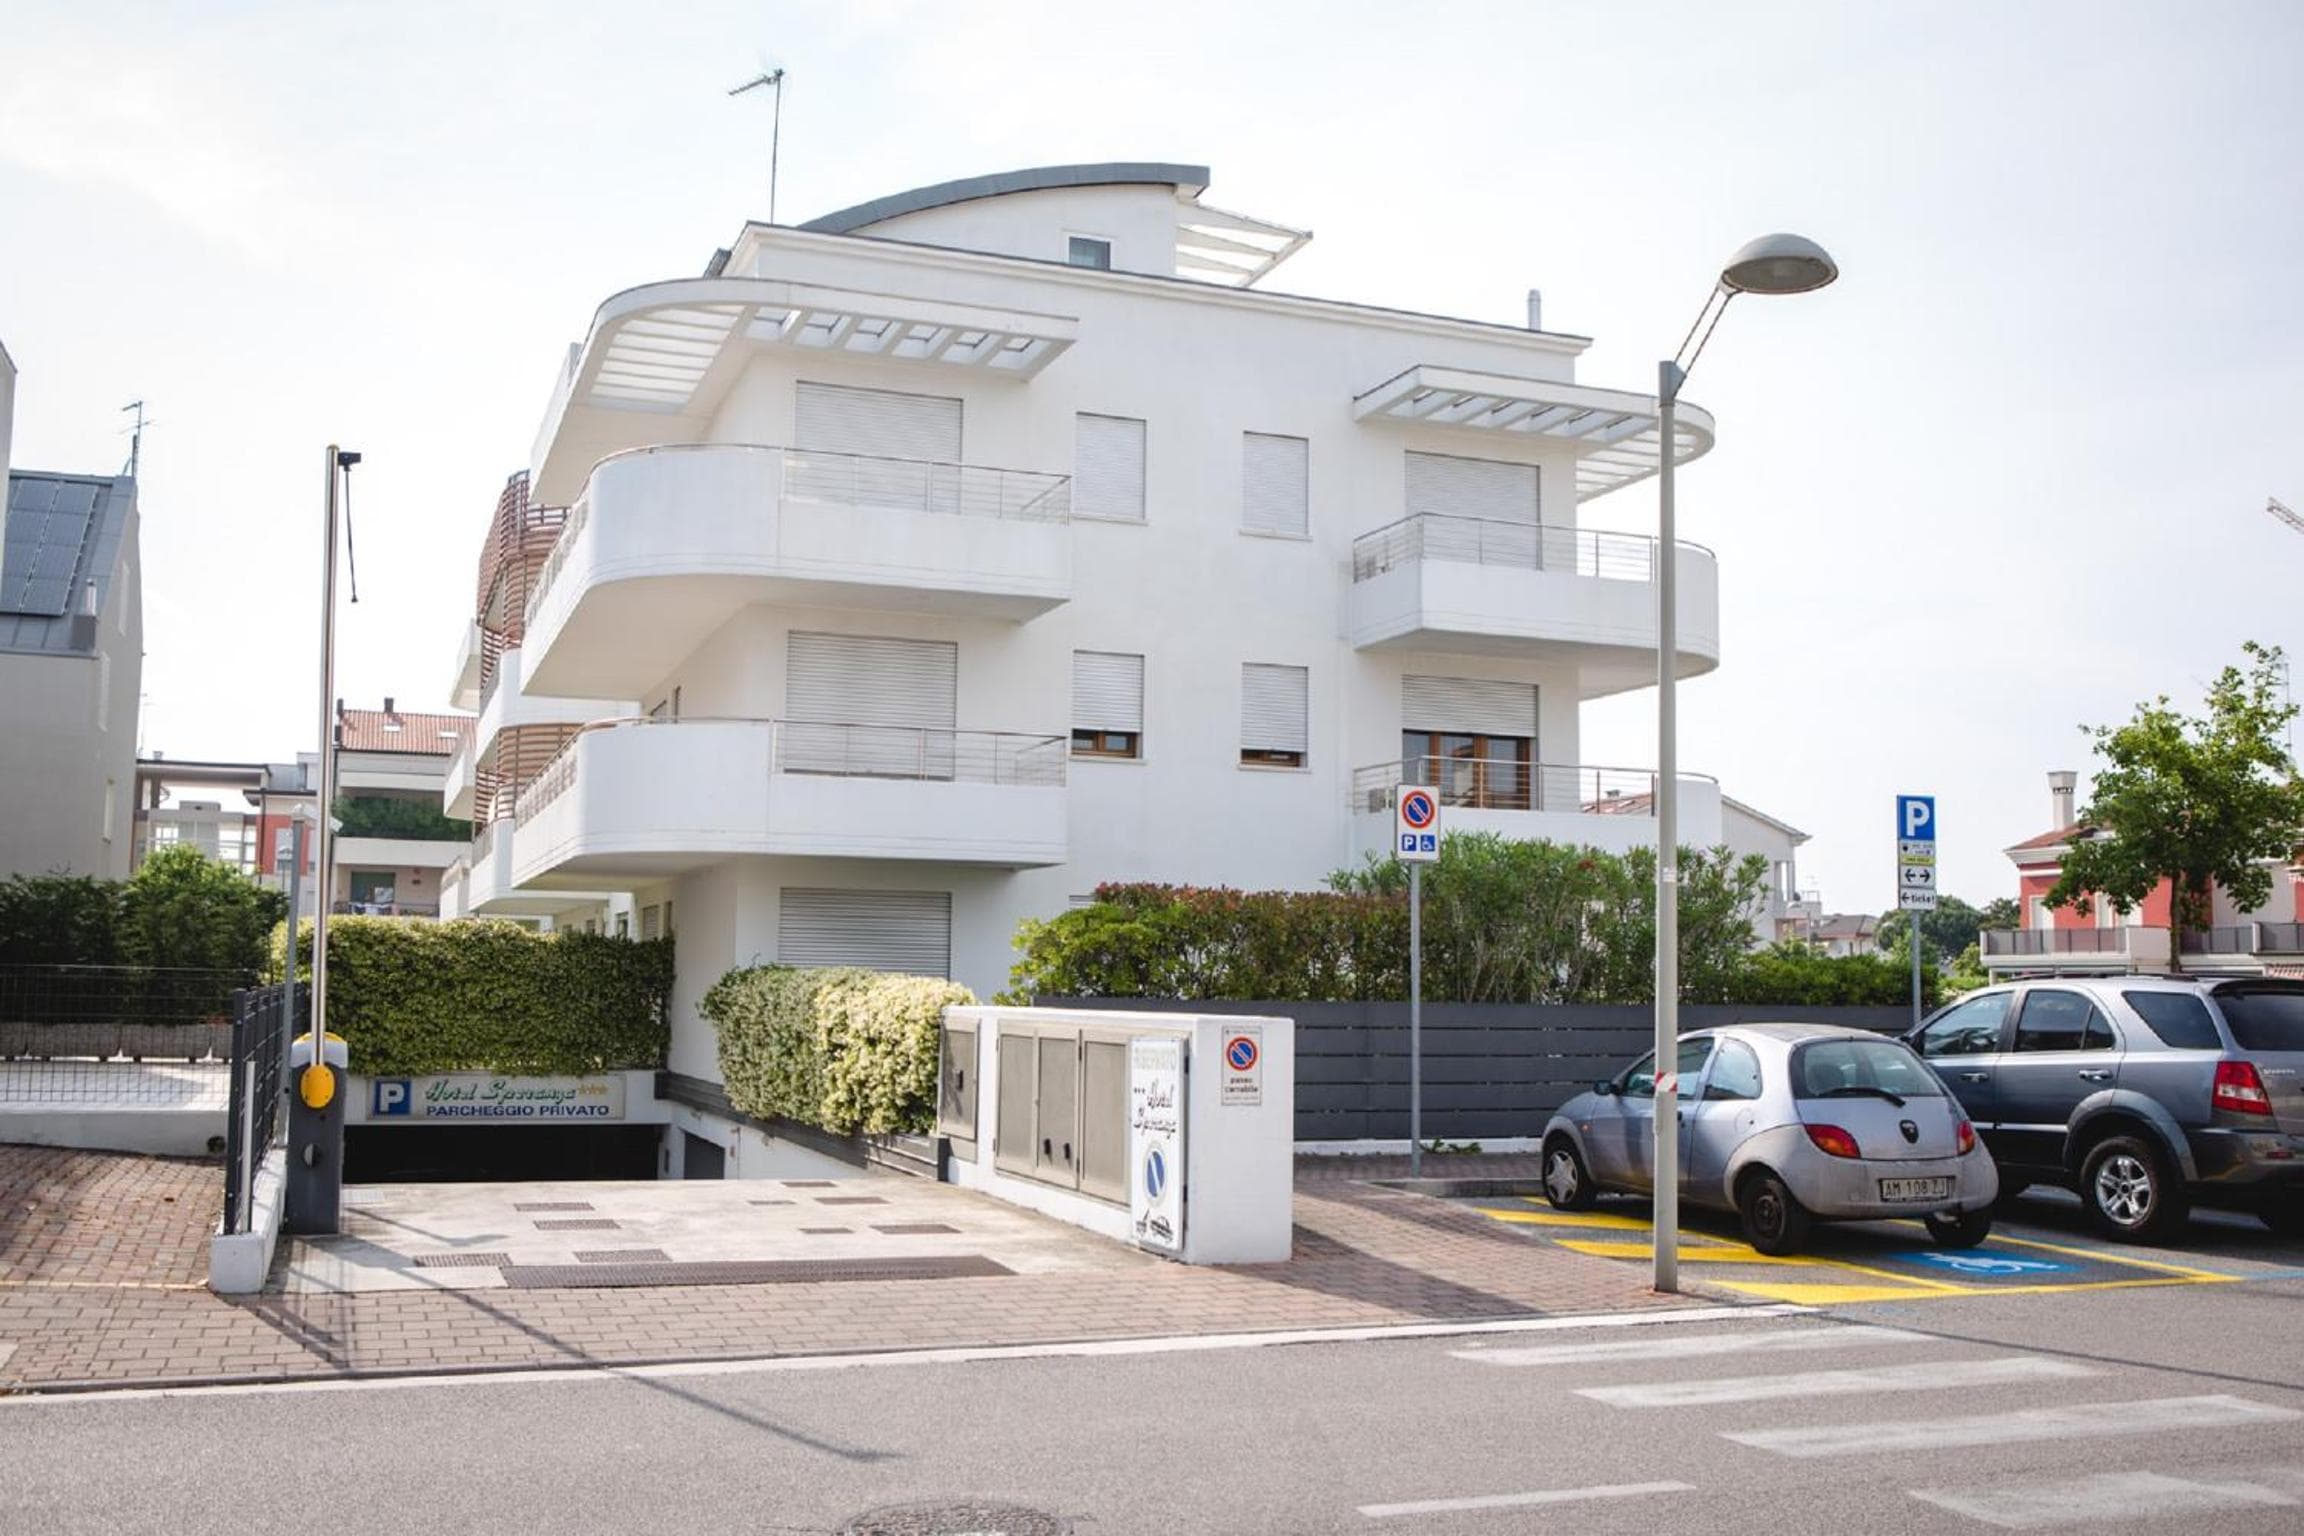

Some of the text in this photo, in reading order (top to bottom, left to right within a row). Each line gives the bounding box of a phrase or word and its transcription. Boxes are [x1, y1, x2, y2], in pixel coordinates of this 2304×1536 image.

[1905, 800, 1930, 836] P
[1403, 836, 1414, 850] P
[1911, 894, 1935, 904] ticket
[379, 1083, 404, 1112] P
[425, 1079, 478, 1101] Hotel
[426, 1105, 609, 1117] PARCHEGGIO PRIVATO
